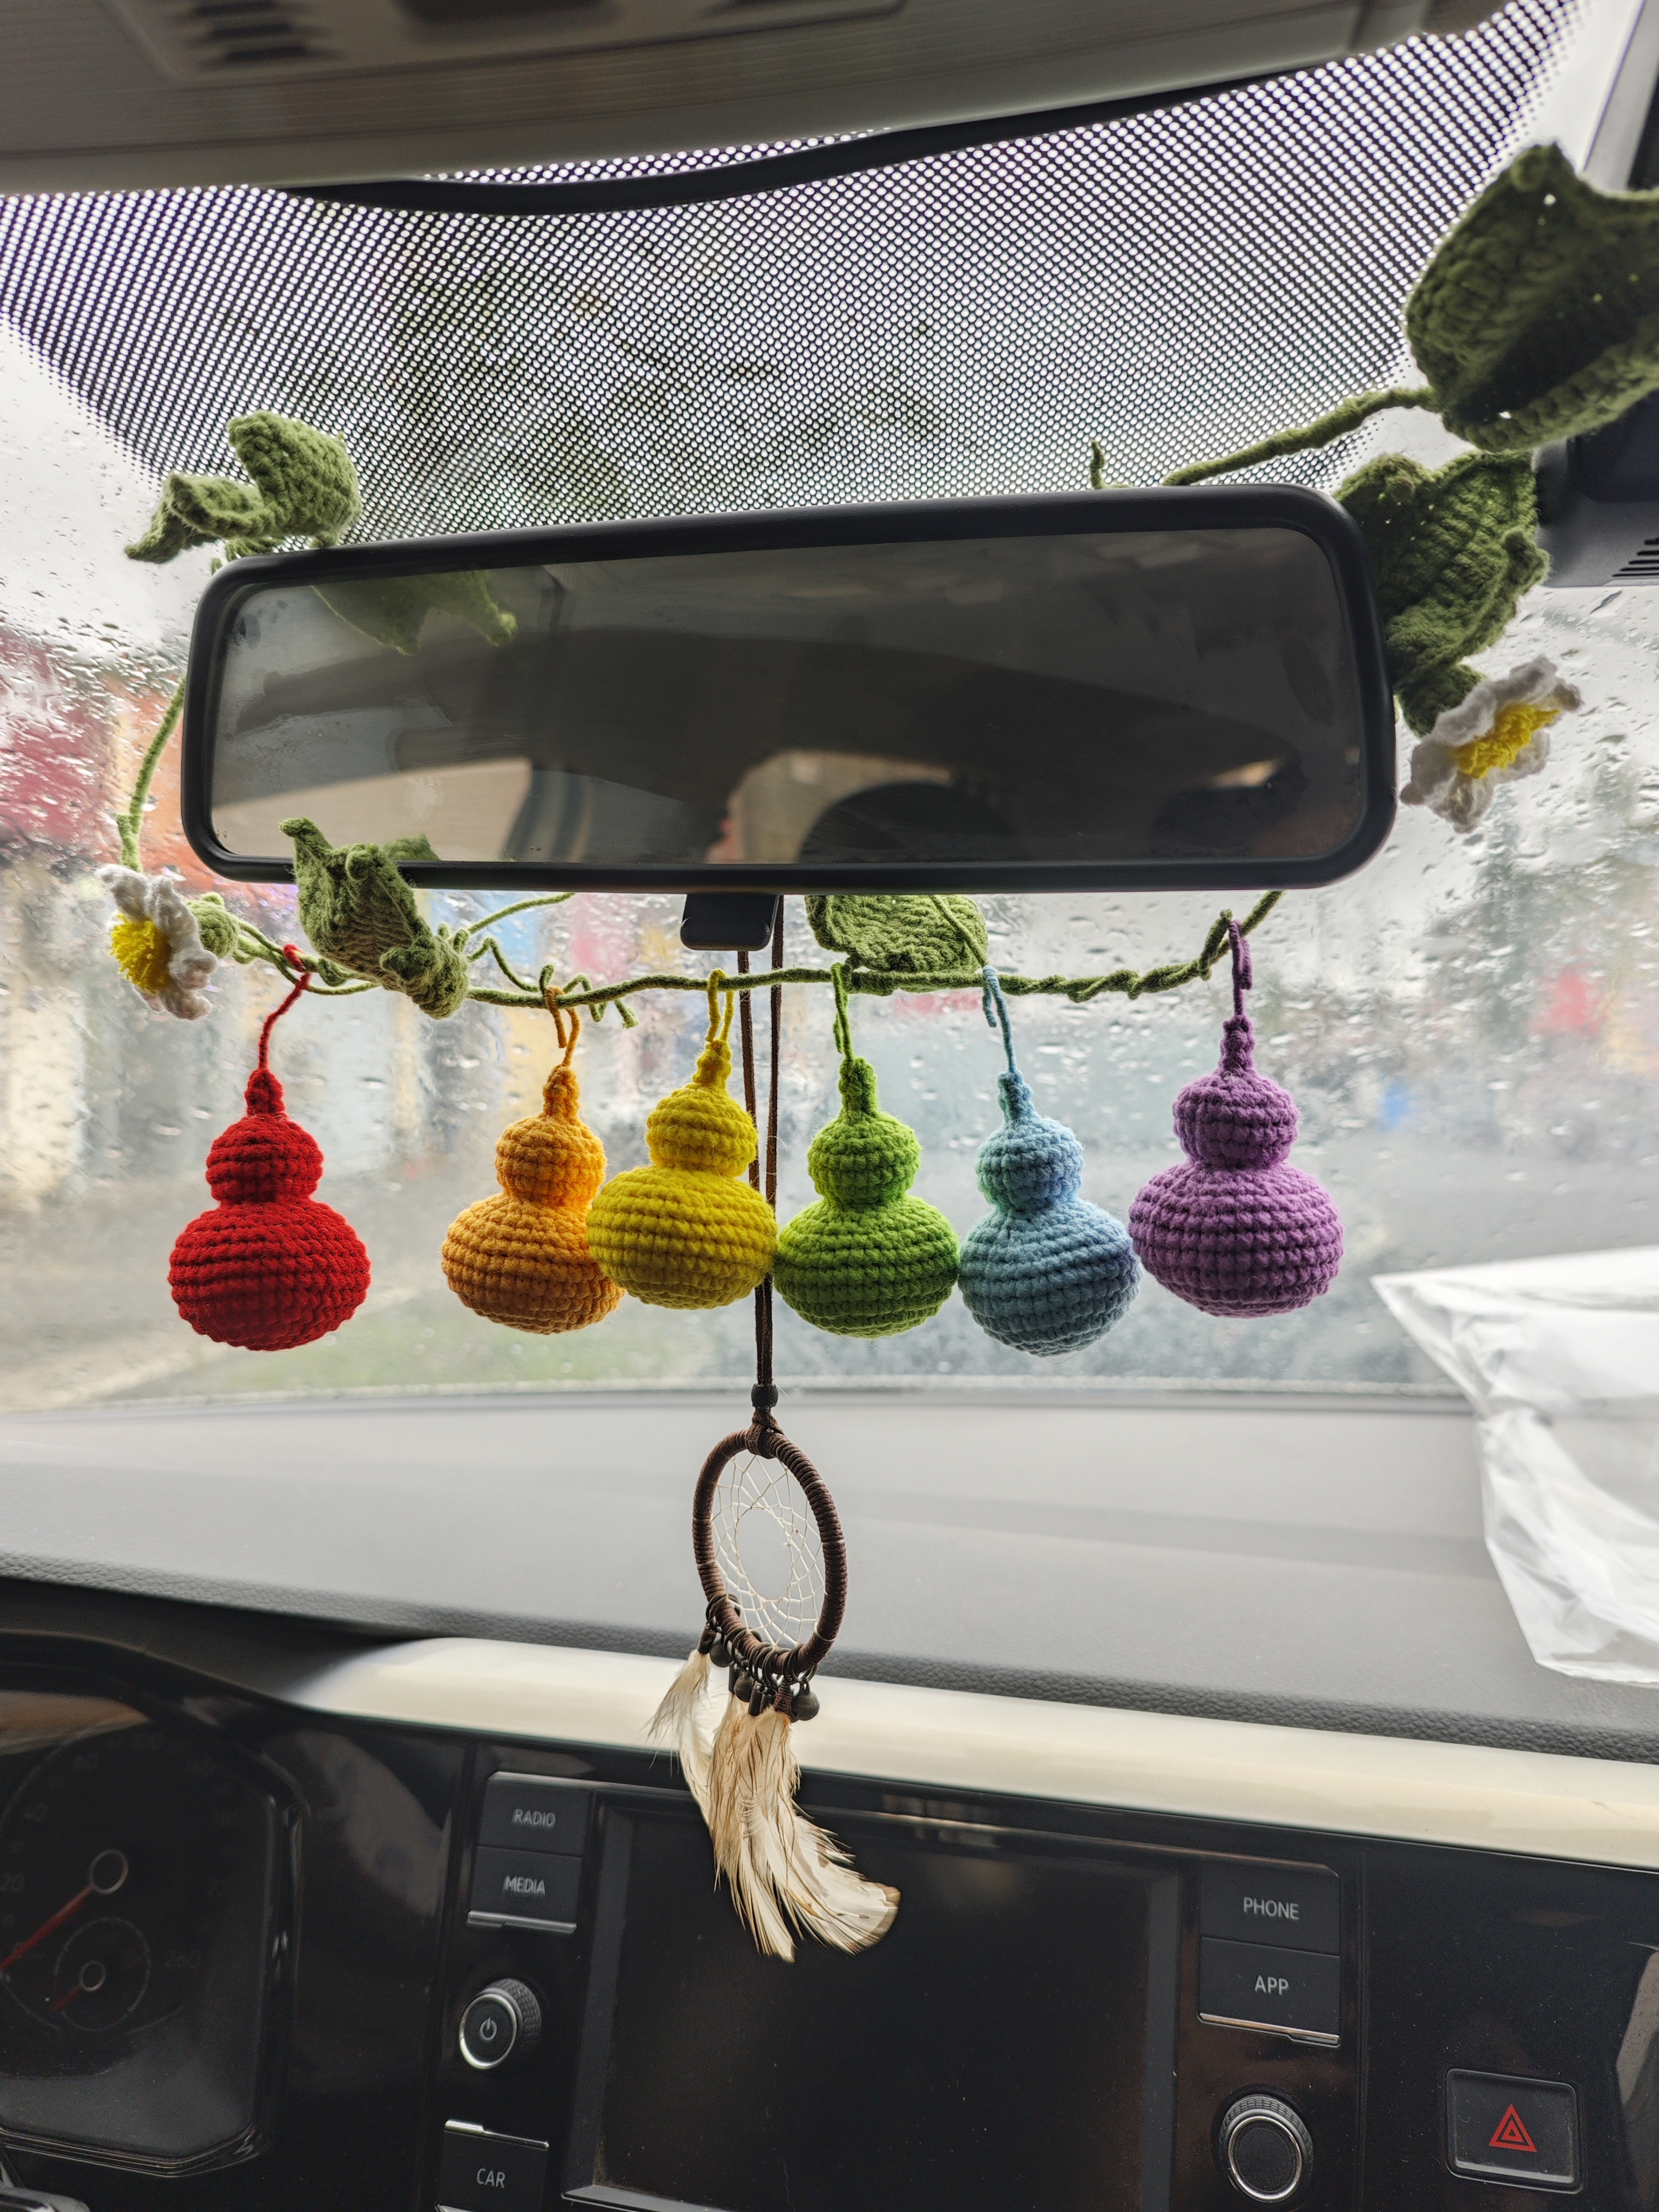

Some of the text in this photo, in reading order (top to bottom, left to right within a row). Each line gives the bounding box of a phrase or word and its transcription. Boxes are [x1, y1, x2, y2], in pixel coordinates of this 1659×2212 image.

[512, 1809, 556, 1828] RADIO
[503, 1876, 545, 1895] MEDIA
[1243, 1897, 1300, 1920] PHONE
[1254, 1975, 1290, 1995] APP
[476, 2168, 506, 2189] CAR
